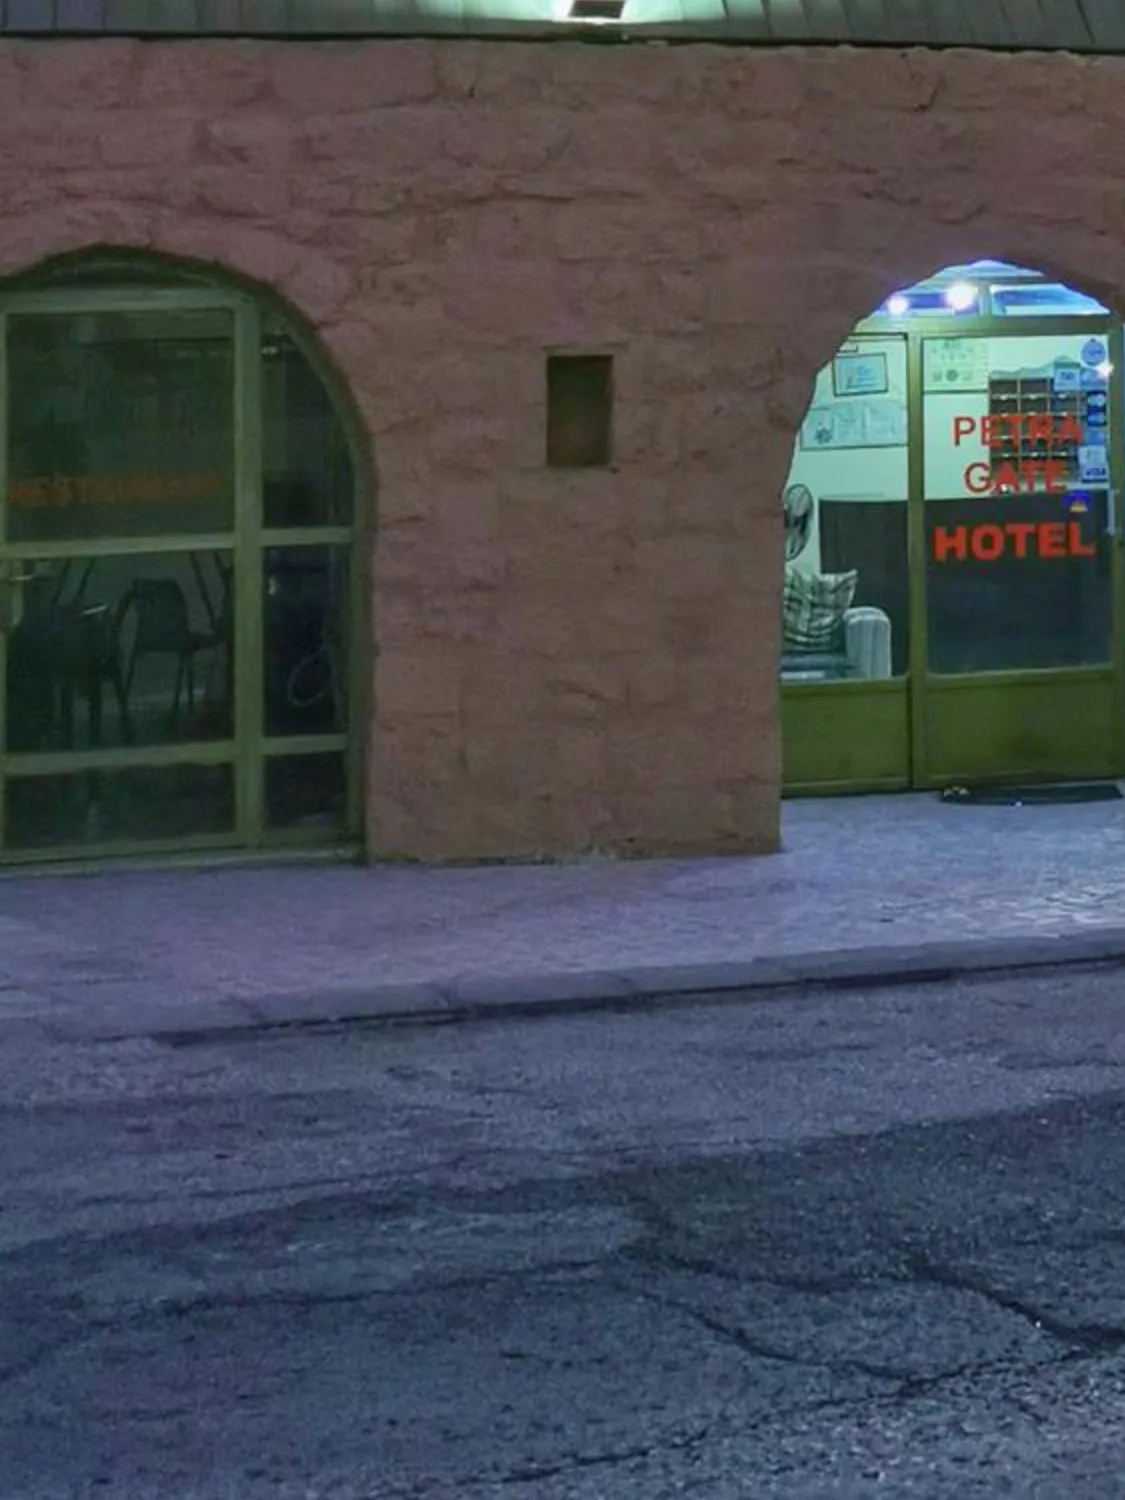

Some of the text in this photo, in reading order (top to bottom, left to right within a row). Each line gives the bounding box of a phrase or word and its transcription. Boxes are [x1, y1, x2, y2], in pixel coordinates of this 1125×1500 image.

[953, 413, 1085, 447] PETRA
[964, 459, 1069, 494] GATE
[933, 521, 1096, 563] HOTEL
